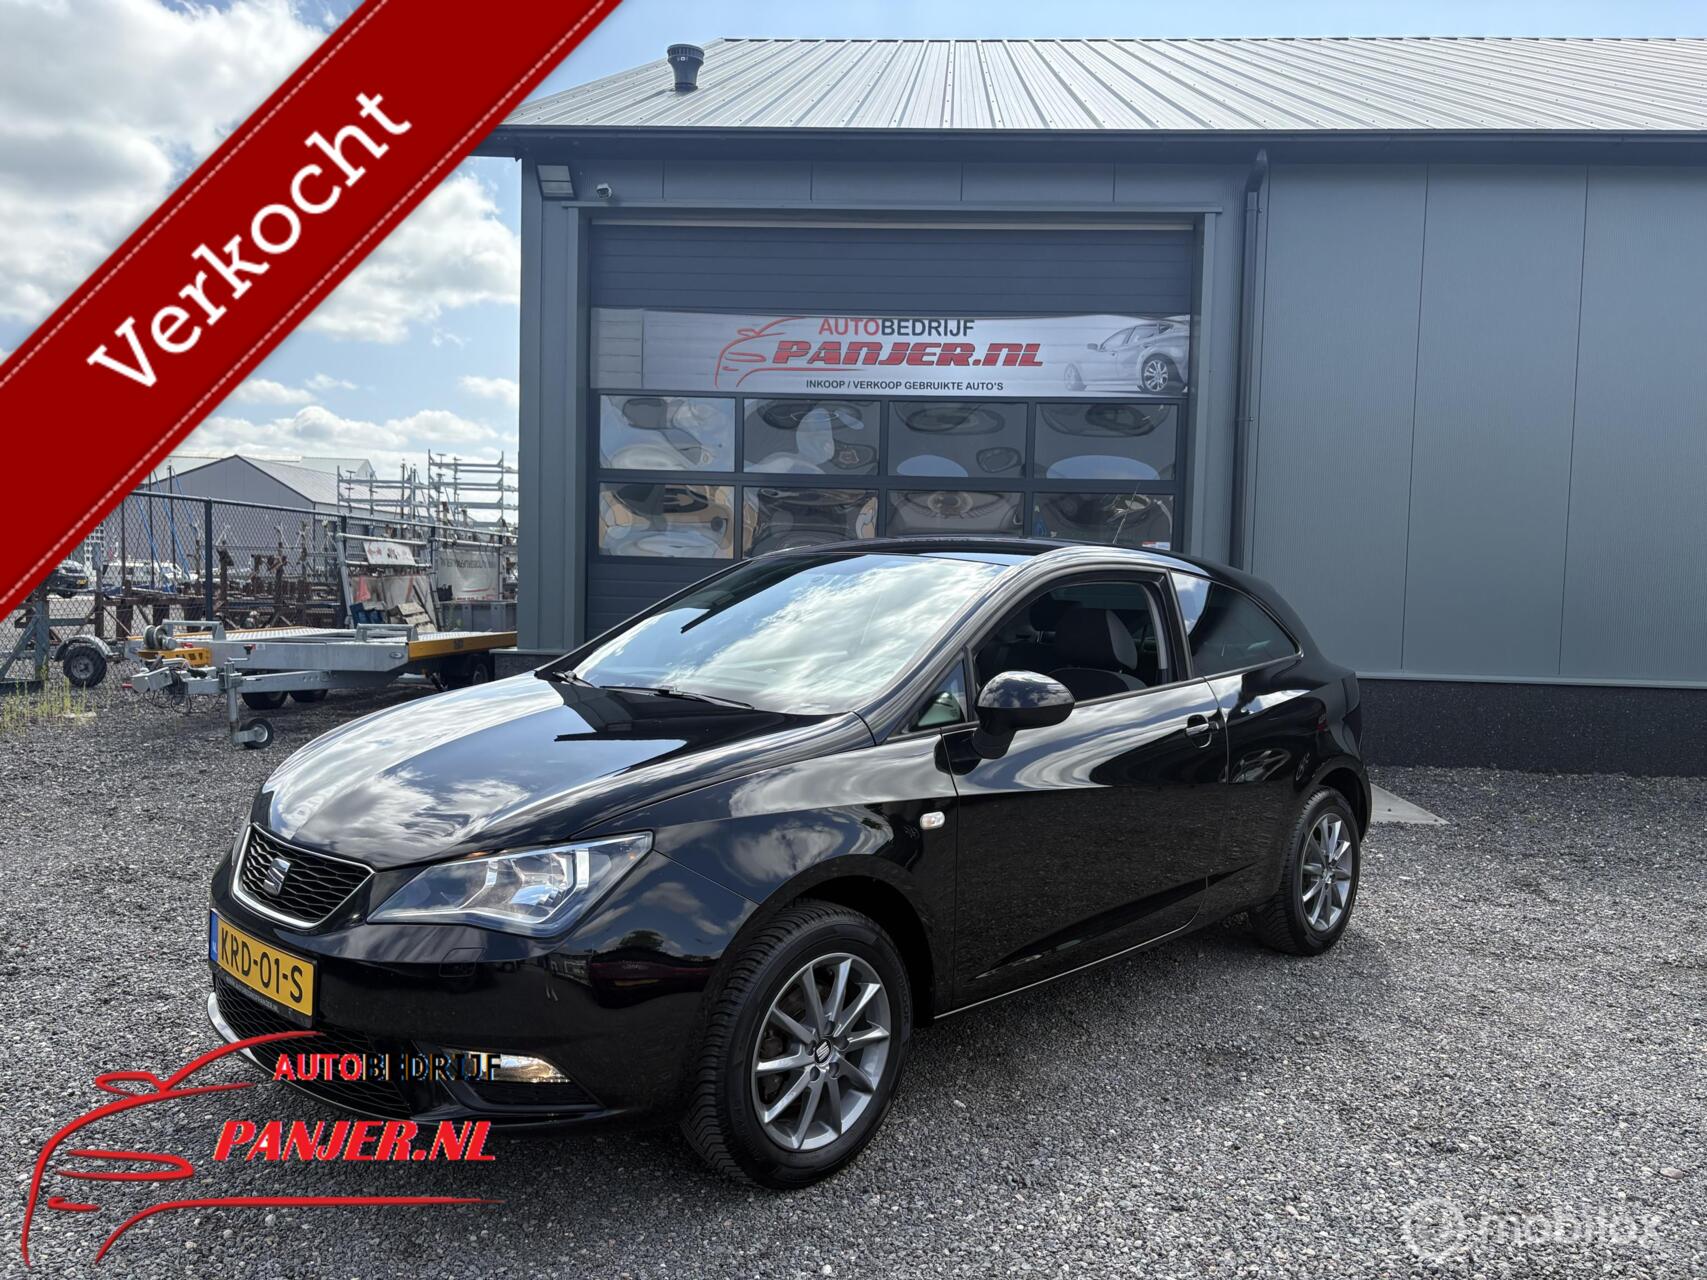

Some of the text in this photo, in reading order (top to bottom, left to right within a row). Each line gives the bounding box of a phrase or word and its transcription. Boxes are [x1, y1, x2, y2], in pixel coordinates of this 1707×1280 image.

[819, 318, 976, 337] AUTOBEDRIJF
[806, 380, 846, 389] INKOOP
[853, 381, 902, 390] VERKOOP
[904, 381, 963, 391] GEBRUIKTE
[965, 382, 1004, 391] AUTO'S
[221, 927, 303, 1004] KRD-01-S
